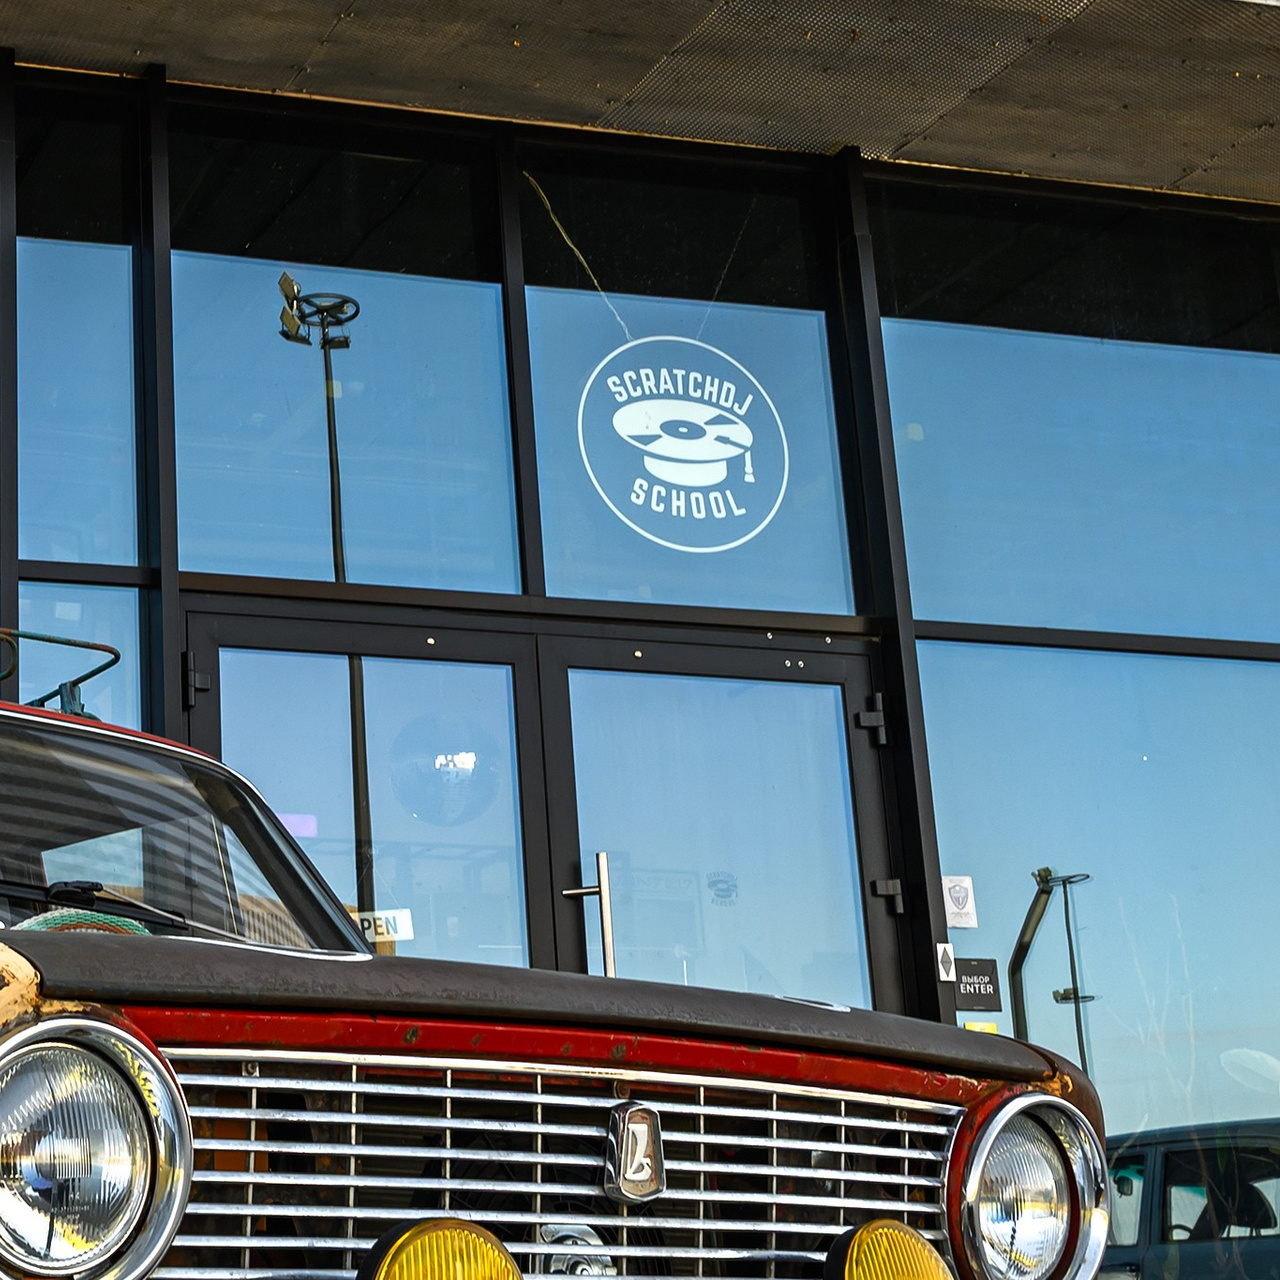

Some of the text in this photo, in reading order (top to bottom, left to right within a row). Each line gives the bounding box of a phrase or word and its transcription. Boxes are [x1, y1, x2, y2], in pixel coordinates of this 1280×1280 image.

[630, 477, 747, 520] SCHOOL
[355, 916, 398, 936] PEN
[960, 983, 994, 995] ENTER
